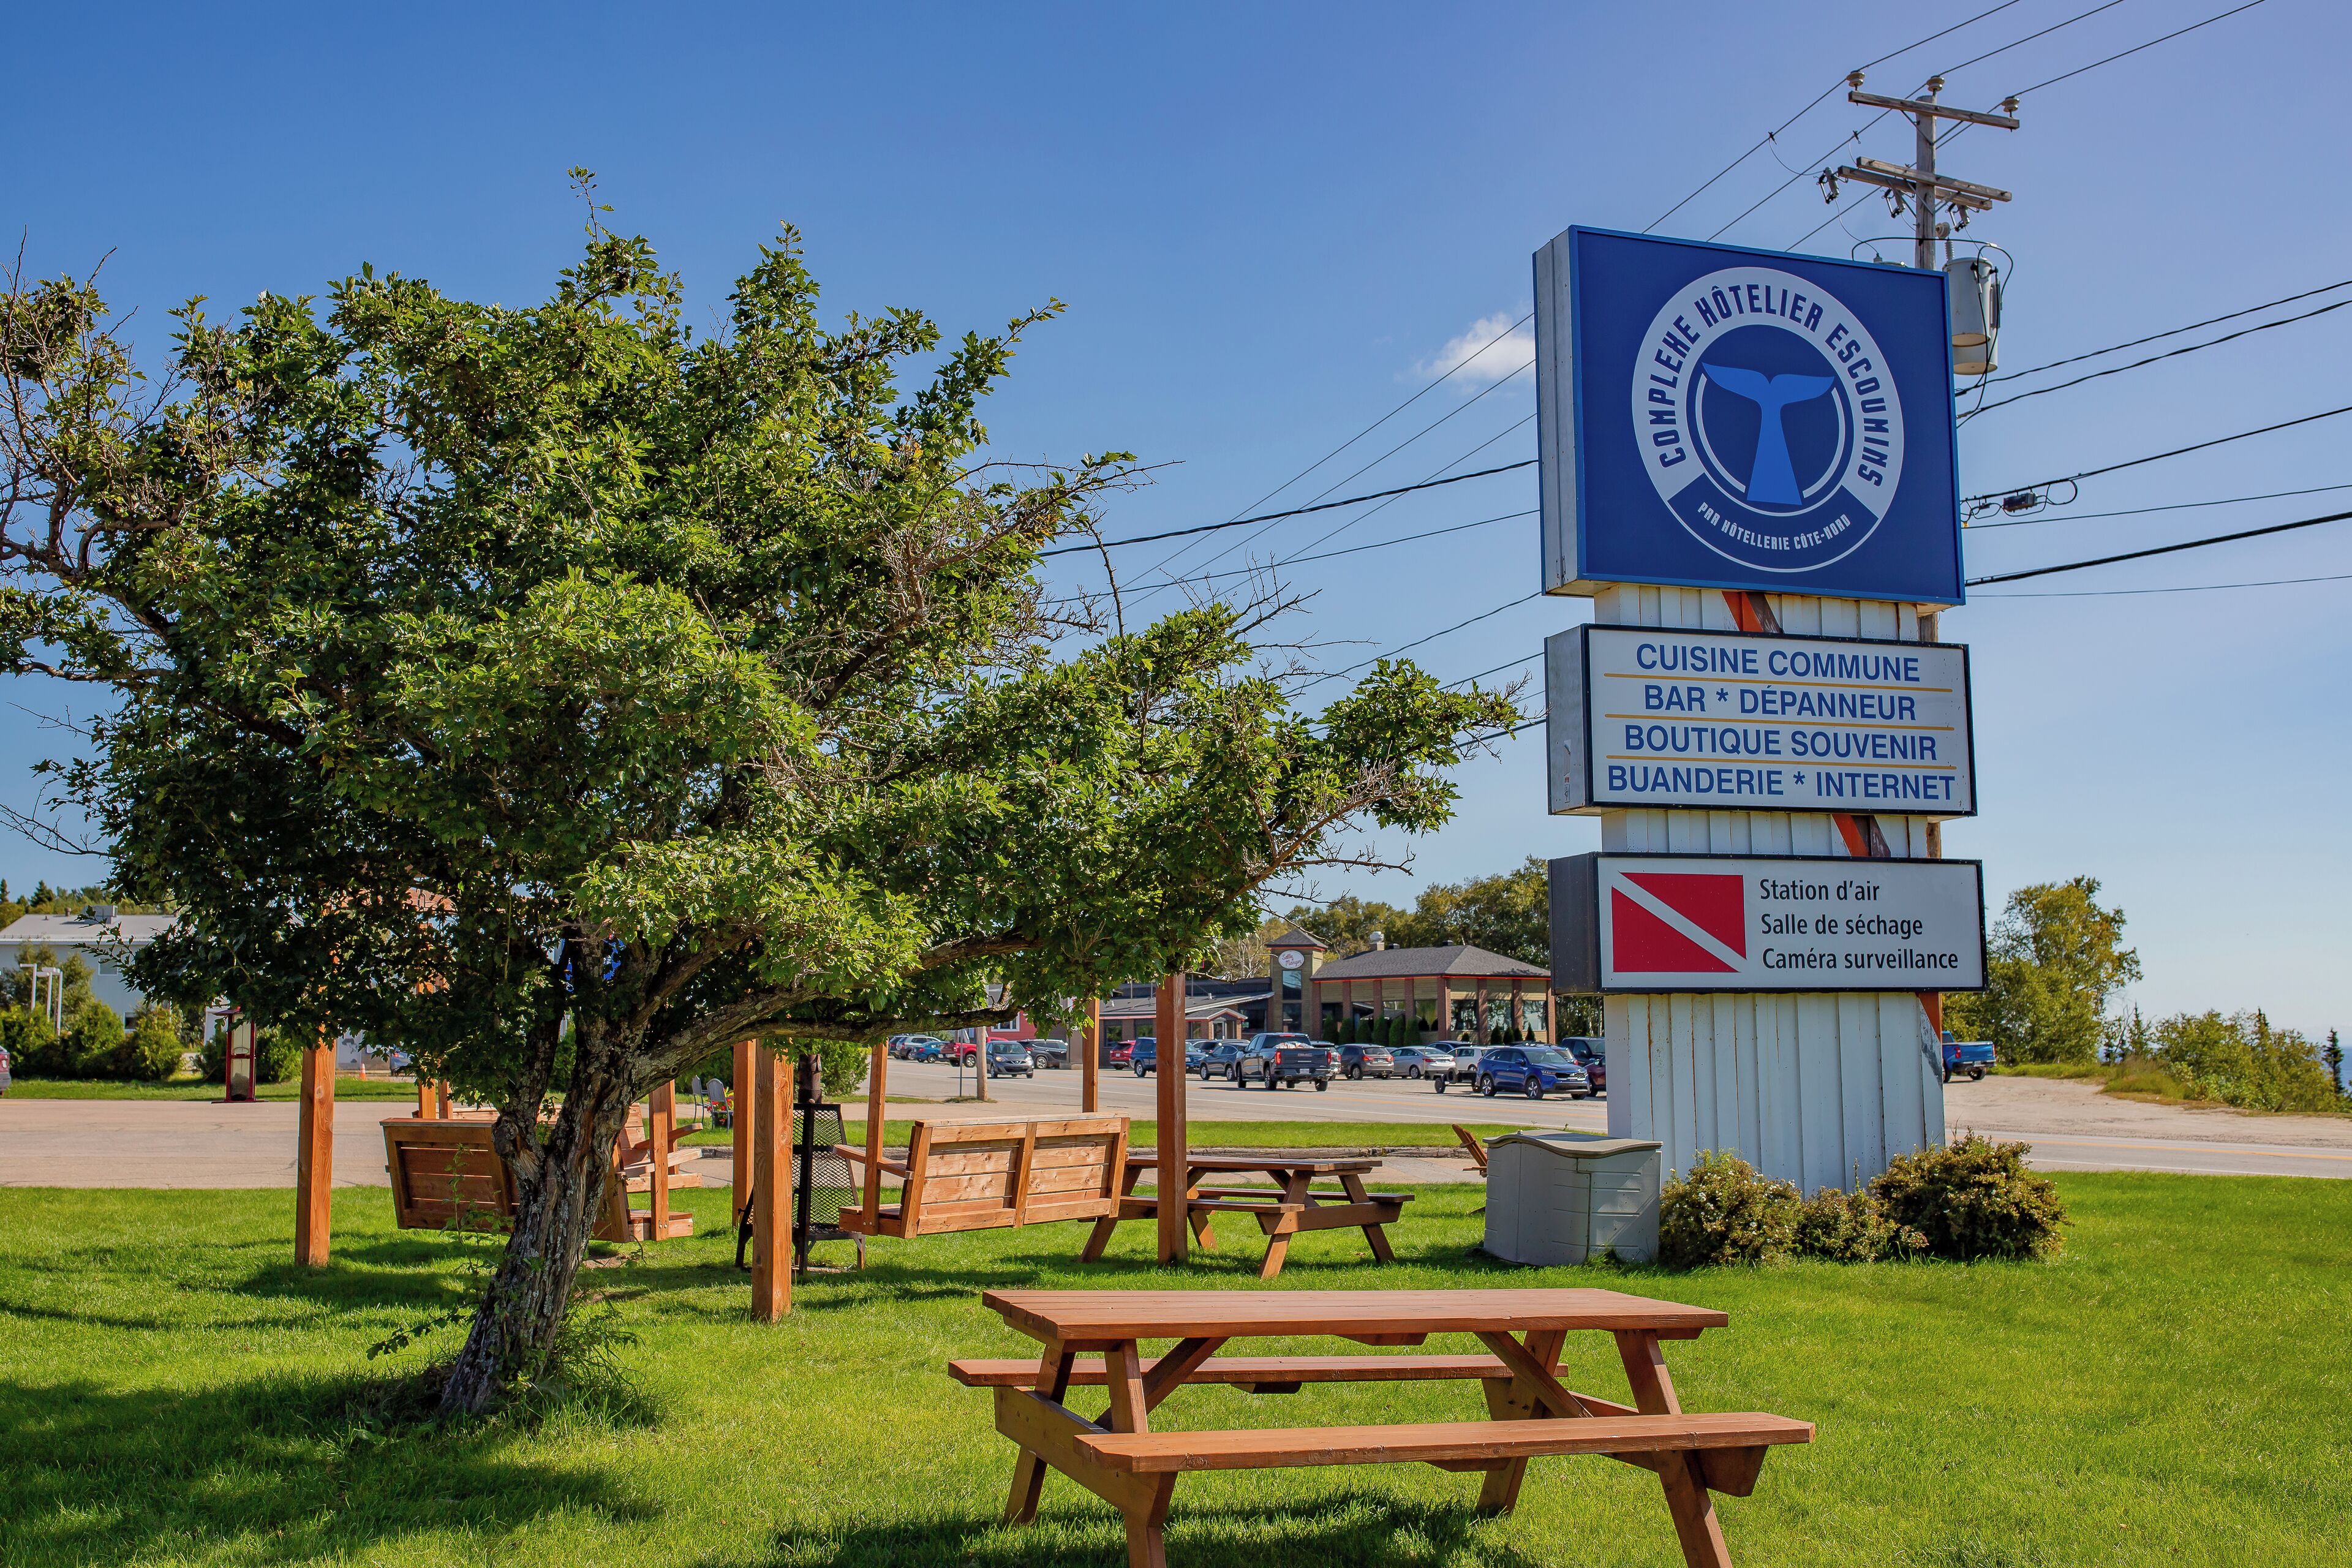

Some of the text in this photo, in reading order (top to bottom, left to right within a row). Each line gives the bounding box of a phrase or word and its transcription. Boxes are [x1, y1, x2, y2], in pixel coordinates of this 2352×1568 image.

[1648, 284, 1890, 487] COMPLEXE HÔTELIER ESCOUMINS
[1697, 502, 1851, 550] PAR HÔTELLERIE CÔTE-NORD
[1636, 642, 1921, 683] CUISINE COMMUNE
[1645, 684, 1917, 722] BAR DÉPANNEUR
[1625, 723, 1937, 762] BOUTIQUE SOUVENIR
[1608, 764, 1784, 796] BUANDERIE
[1816, 770, 1956, 802] INTERNET
[1760, 878, 1829, 900] Station
[1761, 913, 1923, 940] Salle de séchage
[1762, 947, 1958, 969] Caméra surveillance
